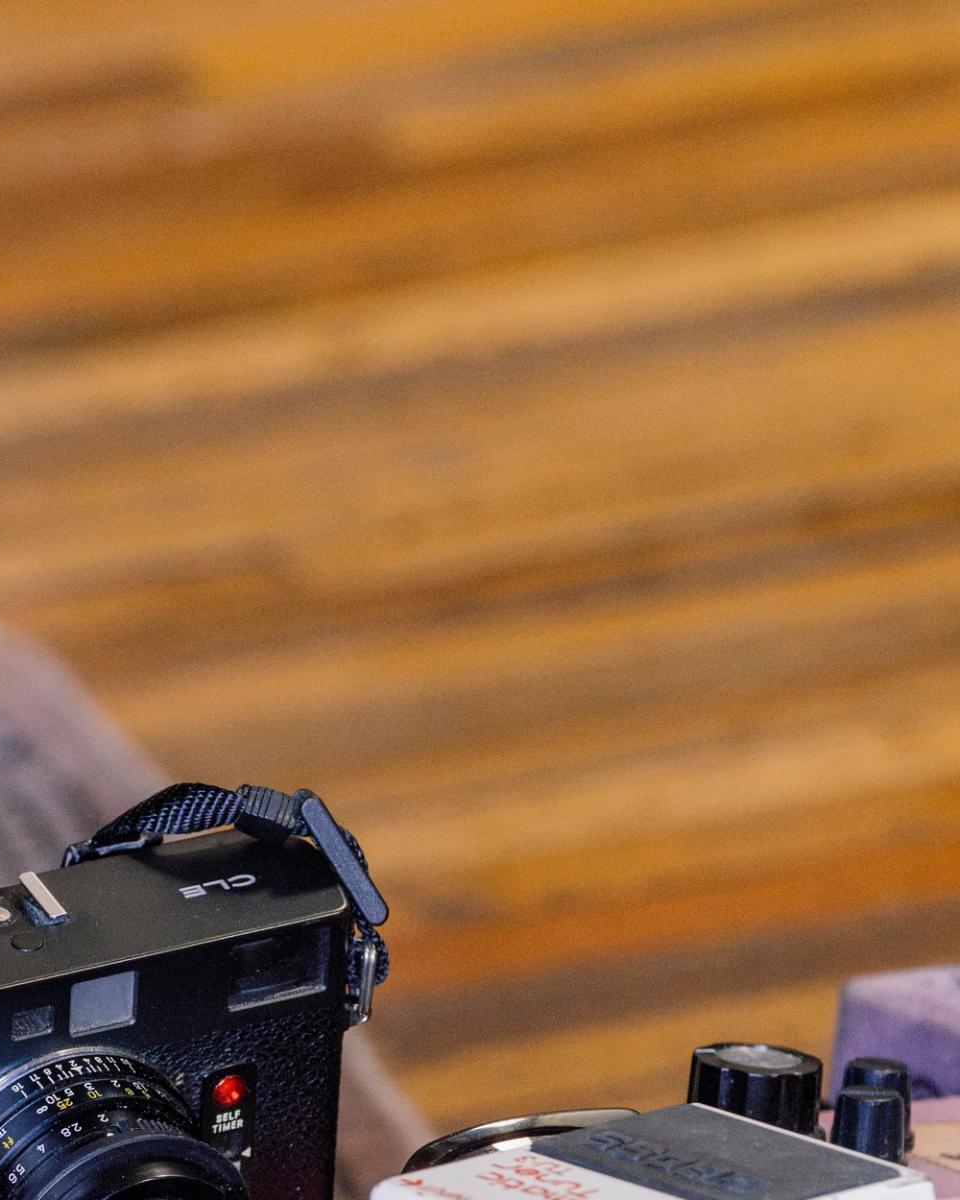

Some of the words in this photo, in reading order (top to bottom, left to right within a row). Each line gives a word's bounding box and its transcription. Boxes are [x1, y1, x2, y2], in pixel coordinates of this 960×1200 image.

[179, 874, 256, 899] CLE
[29, 1073, 41, 1083] 11
[11, 1082, 25, 1093] 16
[84, 1082, 95, 1091] 3
[110, 1080, 121, 1088] 2
[64, 1088, 75, 1097] 5
[87, 1089, 103, 1099] 10
[45, 1093, 61, 1104] 10
[56, 1097, 73, 1110] 25
[97, 1113, 109, 1123] 2
[216, 1109, 241, 1123] SELF
[60, 1122, 82, 1137] 2.8
[212, 1118, 243, 1134] TIMER
[36, 1144, 46, 1153] 4
[8, 1163, 26, 1184] 5.6
